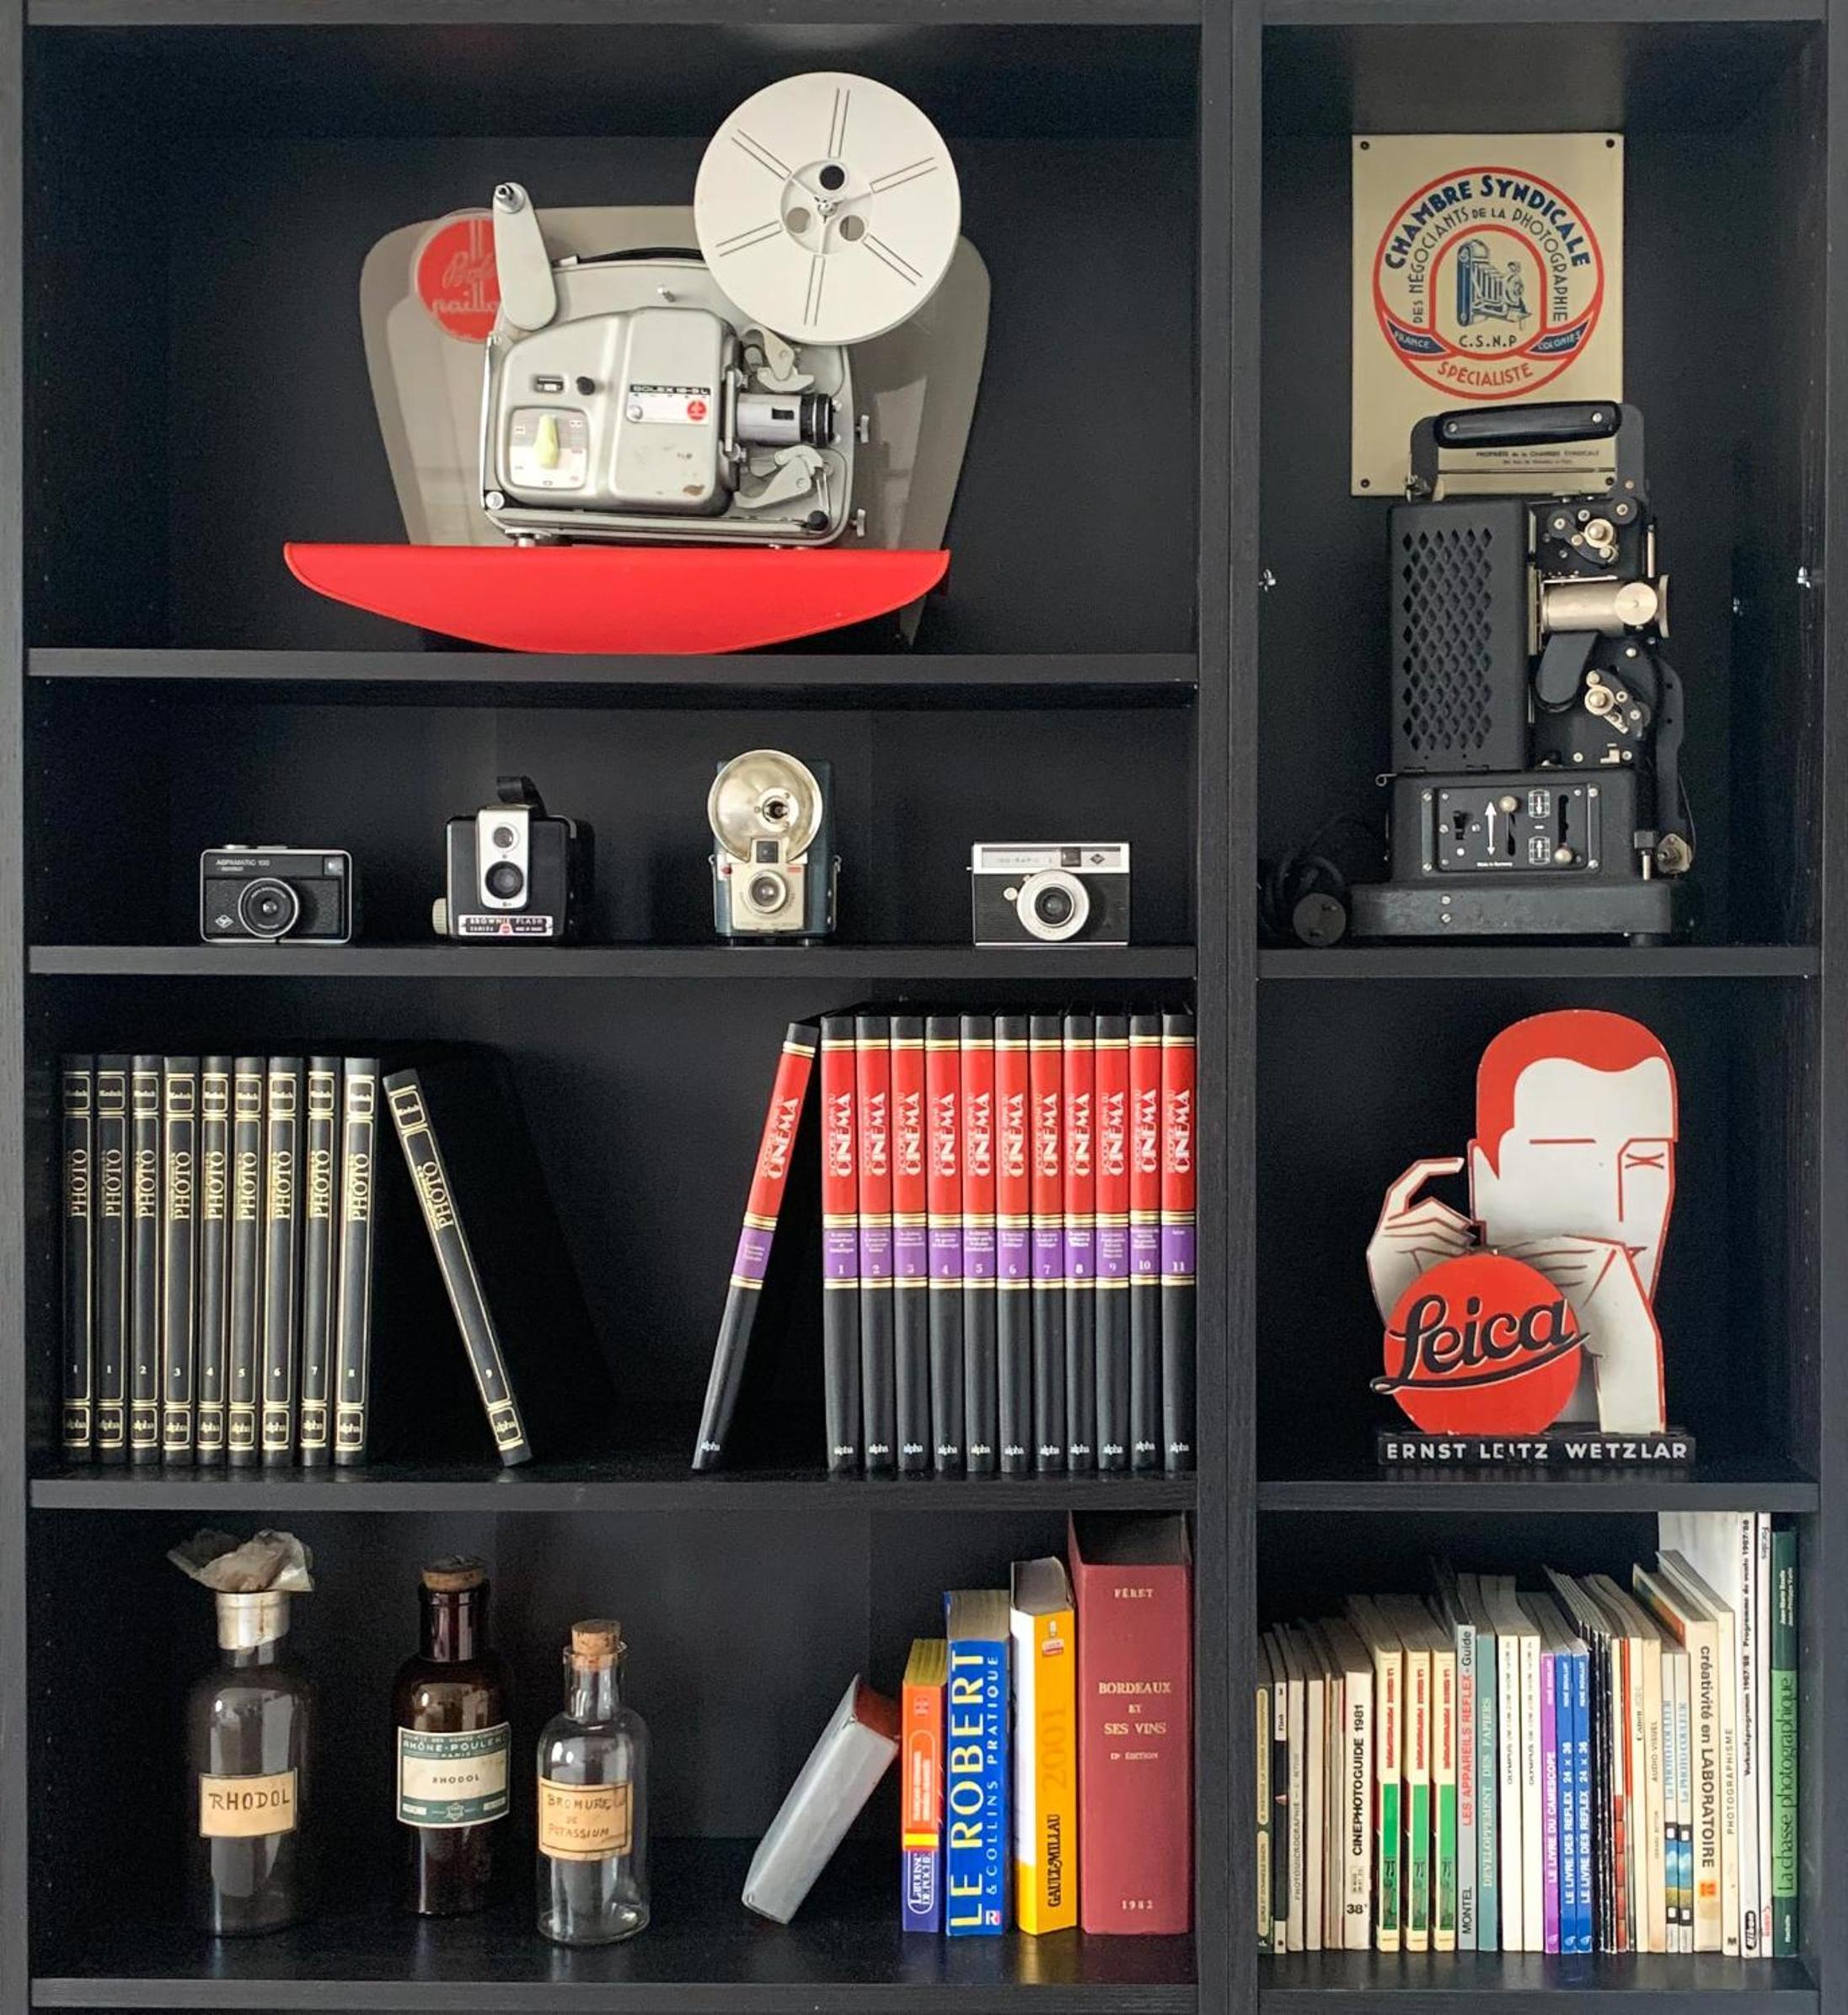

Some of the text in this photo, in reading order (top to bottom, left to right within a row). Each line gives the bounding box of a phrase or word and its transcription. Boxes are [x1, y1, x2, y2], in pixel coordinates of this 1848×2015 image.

[1385, 174, 1590, 269] CHAMBRE SYNDICALE
[1412, 301, 1423, 324] DES
[1472, 208, 1486, 219] DE
[1492, 208, 1506, 219] LA
[1512, 207, 1568, 322] PHOTOGRAPHIE
[1394, 331, 1431, 349] FRANCE
[1537, 330, 1582, 351] COLONIES
[767, 1097, 800, 1179] CINEMA
[836, 1092, 852, 1176] CINEMA
[870, 1092, 887, 1176] CINEMA
[905, 1091, 922, 1176] CINEMA
[940, 1092, 956, 1176] CINEMA
[974, 1092, 990, 1177] CINEMA
[1009, 1092, 1025, 1177] CINEMA
[1042, 1092, 1058, 1176] CINEMA
[1074, 1092, 1090, 1176] CINEMA
[1108, 1091, 1124, 1176] CINEMA
[1141, 1089, 1158, 1173] CINEMA
[1174, 1089, 1190, 1174] CINEMA
[72, 1150, 88, 1218] PHOTO
[105, 1150, 122, 1218] PHOTO
[140, 1150, 156, 1218] PHOTO
[174, 1151, 191, 1220] PHOTO
[208, 1150, 224, 1219] PHOTO
[240, 1151, 256, 1220] PHOTO
[275, 1150, 292, 1219] PHOTO
[313, 1150, 329, 1219] PHOTO
[351, 1153, 368, 1221] PHOTO
[423, 1160, 453, 1227] PHOTO
[838, 1265, 844, 1274] 1
[872, 1265, 881, 1274] 2
[941, 1264, 949, 1274] 4
[976, 1264, 983, 1273] 5
[1010, 1265, 1017, 1274] 6
[1043, 1265, 1051, 1274] 7
[1075, 1264, 1084, 1274] 8
[1138, 1260, 1151, 1270] 10
[1172, 1261, 1186, 1272] 11
[1369, 1294, 1591, 1395] Leica
[106, 1364, 112, 1375] 1
[139, 1365, 147, 1375] 2
[174, 1367, 181, 1376] 3
[206, 1367, 214, 1376] 4
[238, 1368, 246, 1377] 5
[273, 1367, 281, 1376] 6
[310, 1365, 318, 1375] 7
[348, 1369, 355, 1377] 8
[485, 1369, 493, 1378] 9
[701, 1440, 720, 1452] alpha
[833, 1444, 854, 1455] alpha
[869, 1444, 889, 1455] alpha
[903, 1443, 924, 1455] alpha
[937, 1444, 957, 1456] alpha
[971, 1444, 991, 1455] alpha
[1004, 1445, 1024, 1456] alpha
[1040, 1444, 1060, 1456] alpha
[1070, 1444, 1090, 1455] alpha
[1103, 1444, 1123, 1455] alpha
[1135, 1440, 1155, 1452] alpha
[1170, 1442, 1189, 1454] alpha
[1387, 1443, 1467, 1460] ERNST
[1566, 1443, 1687, 1460] WETZLAR
[1114, 1588, 1154, 1599] FÉRET
[1742, 1584, 1749, 1594] de
[1743, 1597, 1751, 1647] Programme
[1098, 1682, 1171, 1694] BORDEAUX
[1128, 1704, 1141, 1713] ET
[1352, 1704, 1363, 1732] 1981
[1104, 1722, 1166, 1735] SES VINS
[1635, 1710, 1643, 1740] Canon
[1678, 1752, 1688, 1789] PHOTO
[1701, 1646, 1714, 1868] créativité en LABORATOIRE
[432, 1774, 479, 1784] RHODOL
[950, 1649, 984, 1927] LE ROBERT
[986, 1655, 999, 1895] & COLLINS PRATIQUE
[1461, 1631, 1472, 1934] MONTEL LES APPAREILS REFLEX Guide
[1724, 1728, 1734, 1835] PHOTOGRAPHISME
[1776, 1676, 1797, 1890] La chasse photographique
[208, 1787, 290, 1810] RHODOL
[1352, 1738, 1363, 1856] CINEPHOTOGUIDE
[1481, 1697, 1493, 1888] DEVELOPPEMENT DES PAPIERS
[1546, 1752, 1557, 1884] LE LIVRE DU CAMESCOPE
[1562, 1742, 1574, 1904] LE LIVRE DES REFLEX 24 36
[1578, 1742, 1590, 1903] LE LIVRE DES REFLEX 24 36
[1292, 1803, 1302, 1900] PHOTOMICROGRAPHIE
[1122, 1900, 1154, 1910] 1982
[1746, 1912, 1756, 1947] Nikon
